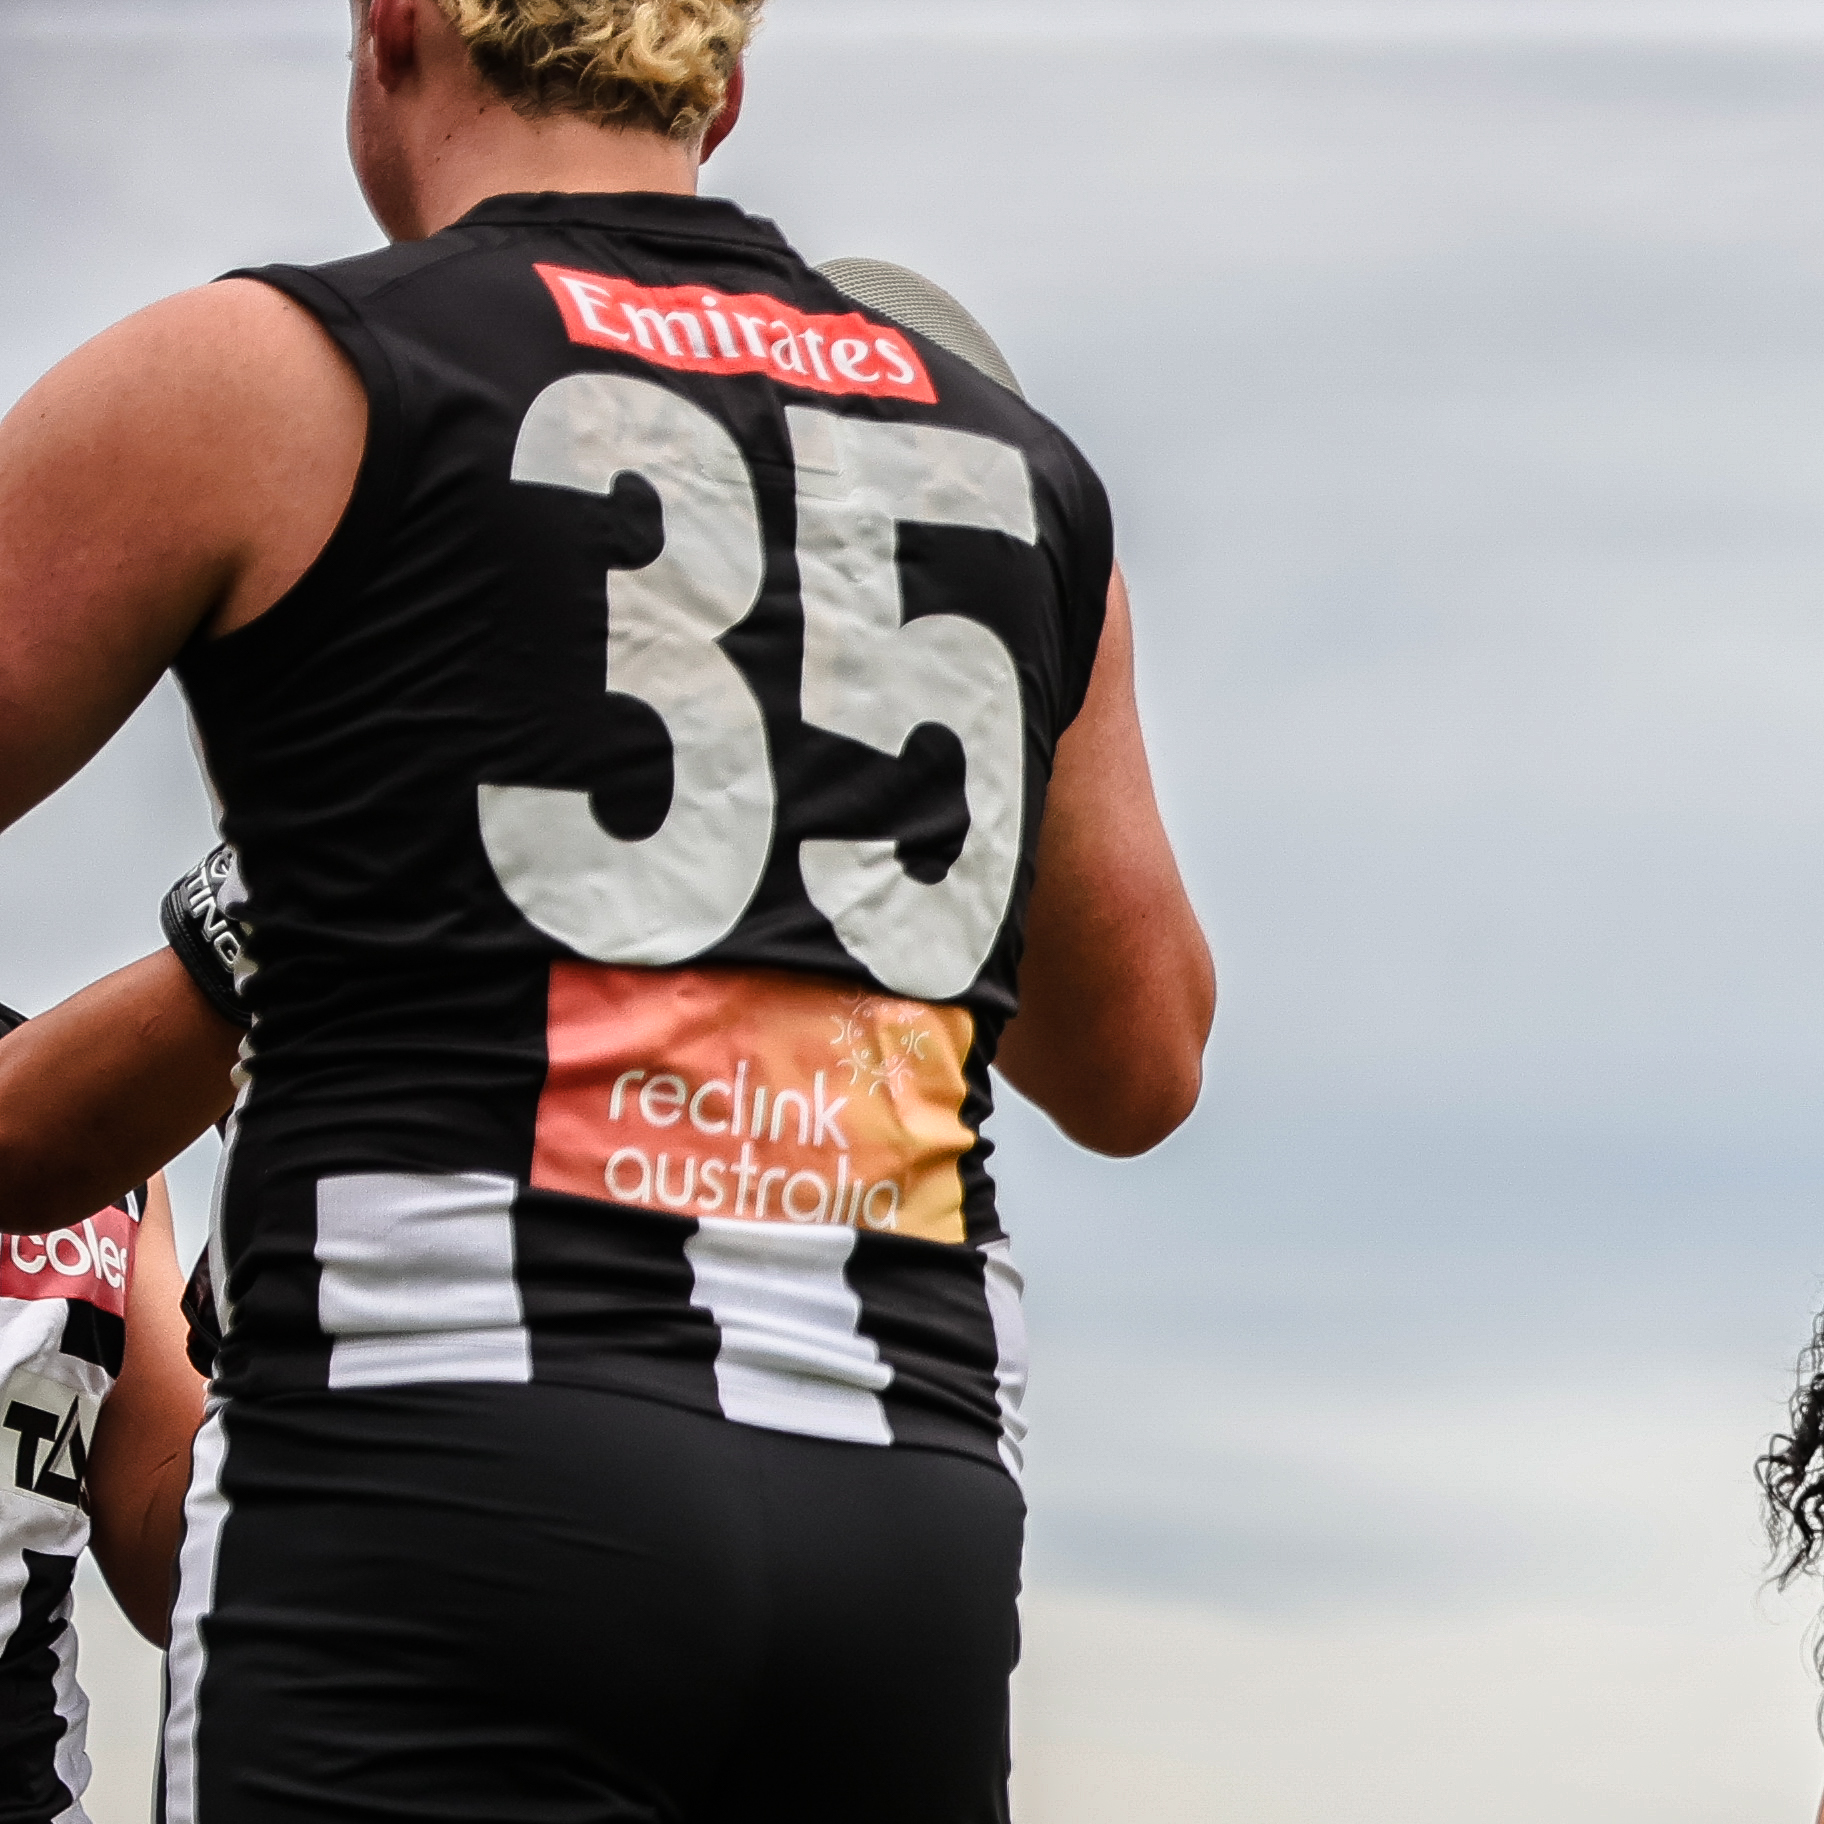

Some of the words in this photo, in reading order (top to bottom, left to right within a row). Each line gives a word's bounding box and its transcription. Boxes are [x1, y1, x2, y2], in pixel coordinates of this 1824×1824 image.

[559, 275, 917, 386] Emirates
[477, 372, 1037, 1000] 35
[607, 1059, 849, 1150] reclink
[603, 1141, 900, 1230] australia
